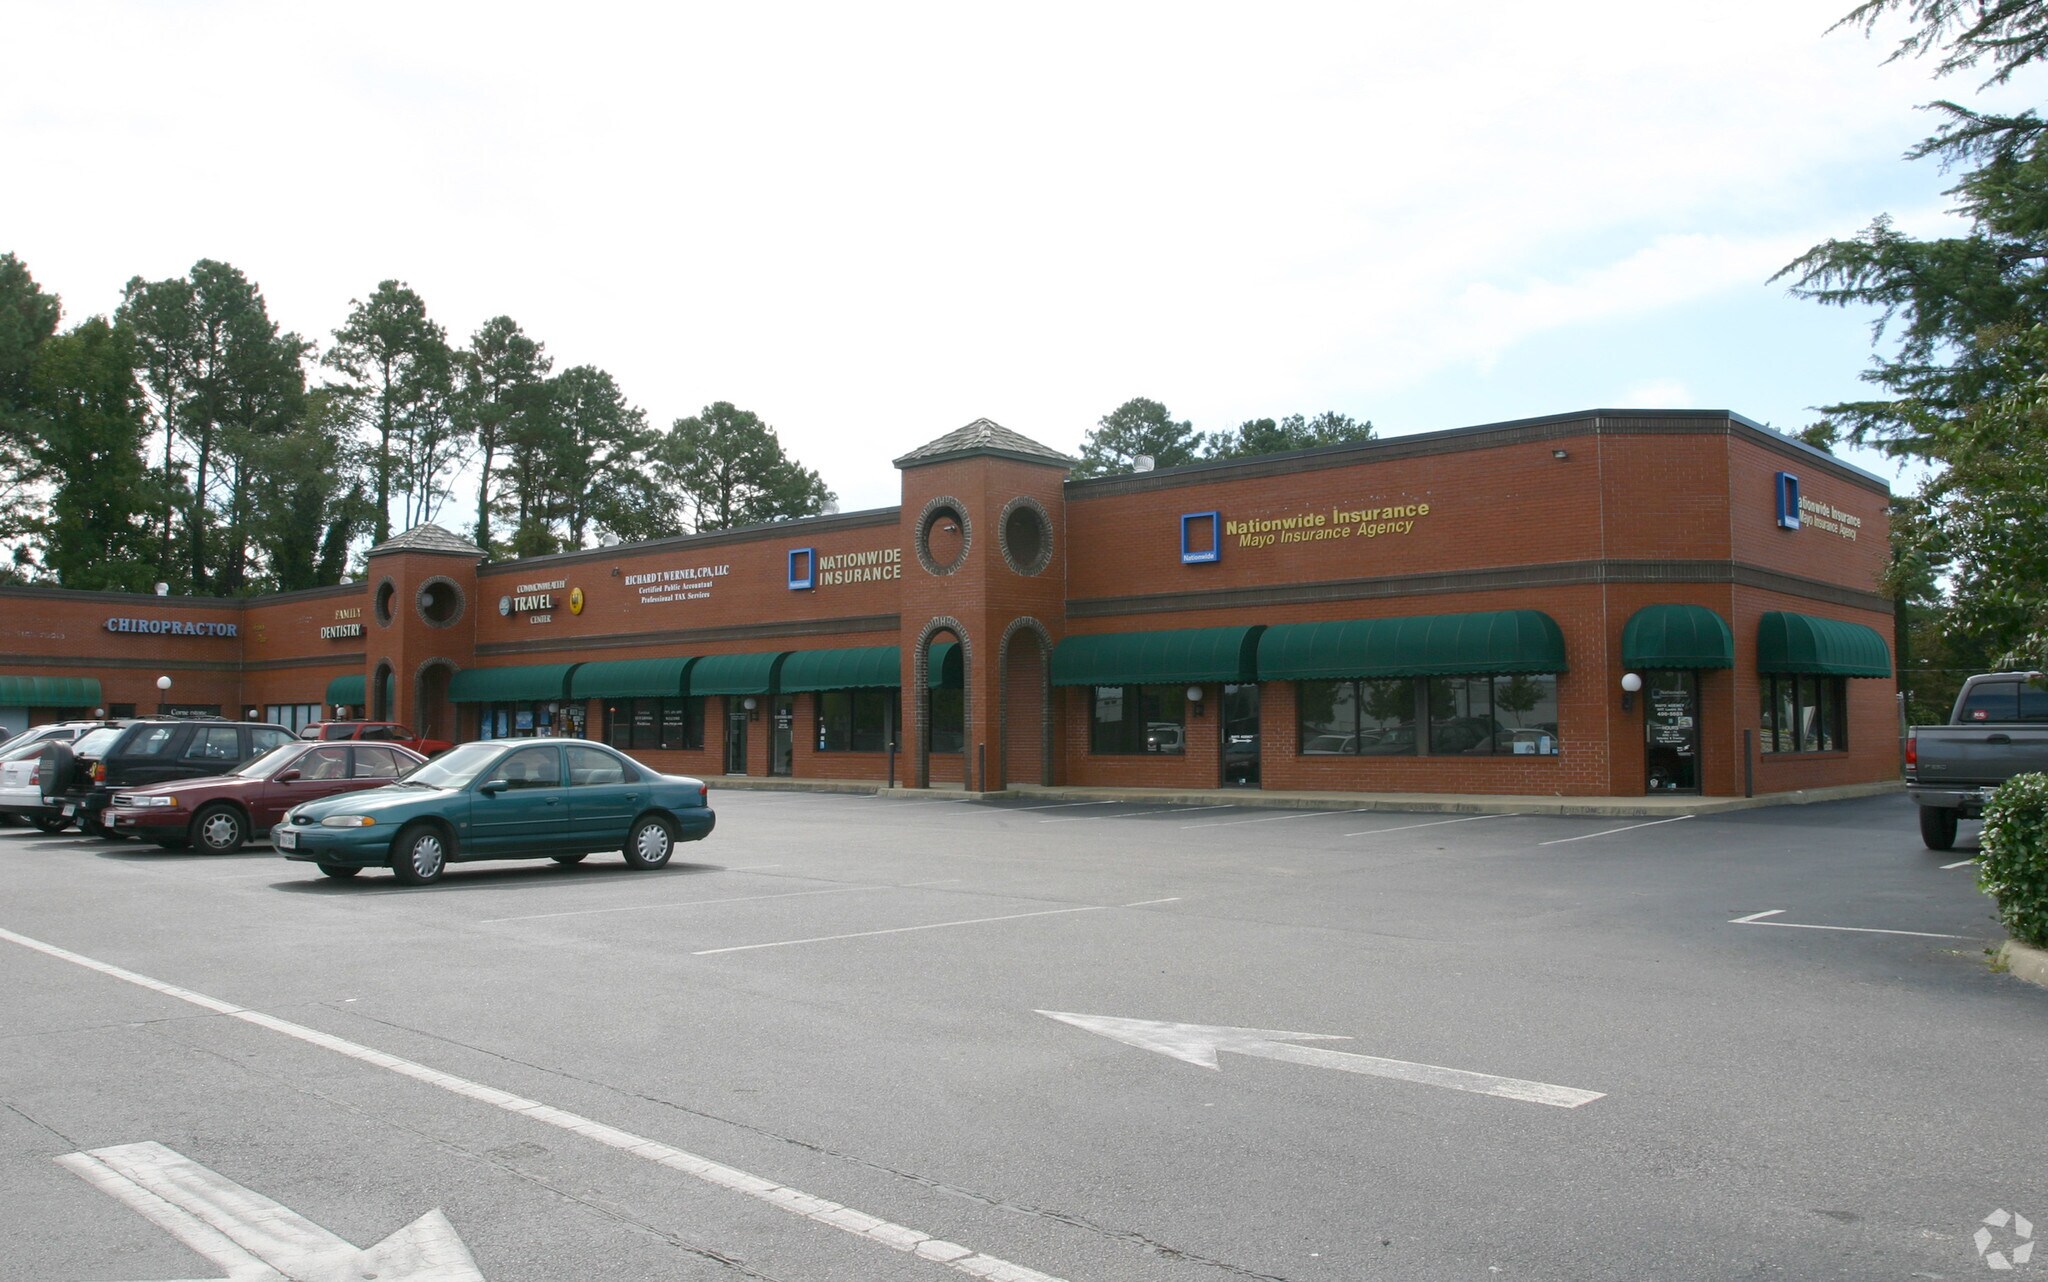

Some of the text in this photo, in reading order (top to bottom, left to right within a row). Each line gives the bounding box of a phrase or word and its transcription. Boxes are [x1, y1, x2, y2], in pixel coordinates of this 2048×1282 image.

[1226, 503, 1430, 536] Nationwide Insurance
[1798, 496, 1861, 528] ationwide Insurance
[1239, 520, 1414, 549] Mayo Insurance Agency
[1814, 514, 1838, 533] Insurance
[1839, 522, 1857, 541] Agency
[819, 548, 902, 571] NATIONWIDE
[1183, 553, 1215, 562] Nationwide
[624, 572, 657, 586] RICHARD
[714, 564, 730, 577] LLC
[819, 564, 902, 586] INSURANCE
[638, 580, 713, 595] Certified Public Accountant
[640, 591, 710, 604] Professional TAX Services
[513, 593, 552, 612] TRAVEL
[335, 607, 362, 620] FAMILY
[530, 614, 552, 625] CENTER
[107, 617, 238, 637] CHIROPRACTOR
[320, 623, 362, 639] DENTISTRY
